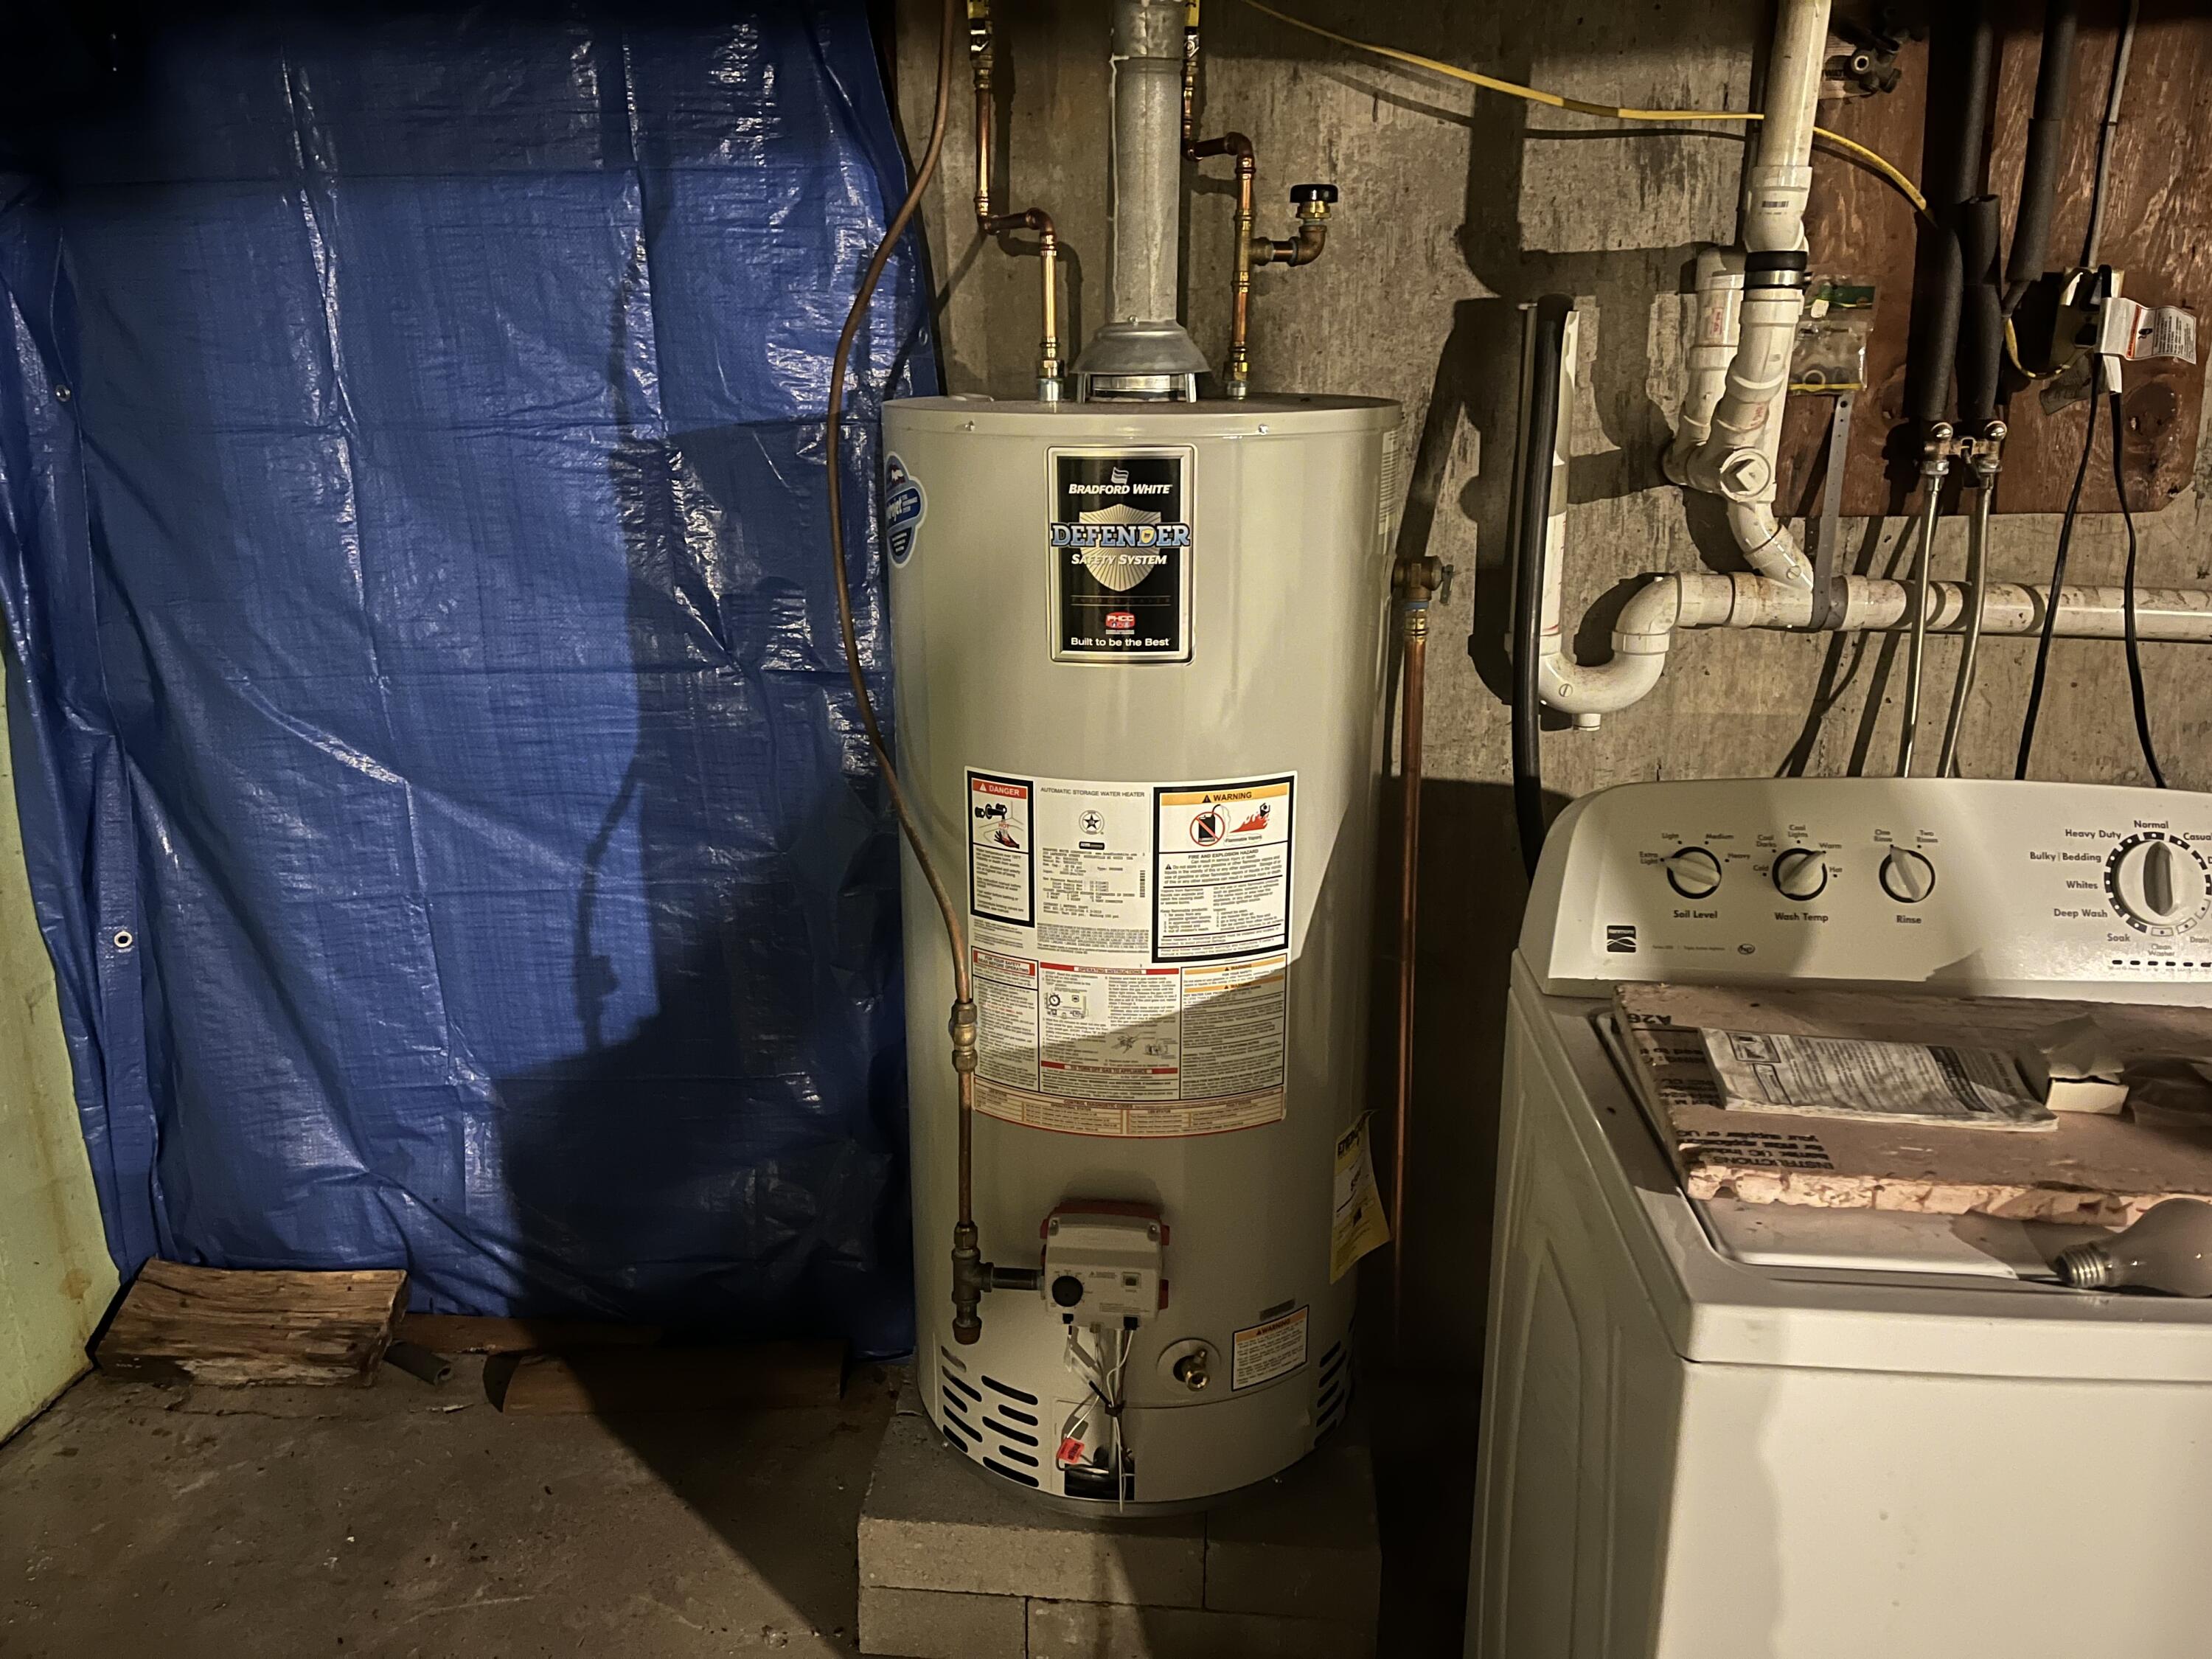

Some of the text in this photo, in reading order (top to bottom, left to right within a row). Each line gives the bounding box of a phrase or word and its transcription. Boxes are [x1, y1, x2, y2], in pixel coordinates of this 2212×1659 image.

[1069, 484, 1170, 494] BRADFORD WHITE
[1051, 522, 1190, 548] DEFENDER
[1071, 554, 1167, 565] SAFETY SYSTEM
[1071, 638, 1093, 646] Built
[1108, 638, 1122, 646] be
[989, 785, 1020, 796] DANGER
[1040, 787, 1071, 795] AUTOMATIC
[1213, 792, 1252, 801] WARNING
[2134, 820, 2169, 830] Normal
[2065, 829, 2121, 840] Heavy Duty
[2029, 852, 2101, 863] Bulky Bedding
[2066, 880, 2098, 889] Whites
[1673, 910, 1718, 919] Soil Level
[1774, 911, 1829, 923] Wash Temp
[2053, 908, 2108, 918] Deep Wash
[1896, 914, 1921, 924] Rinse
[2107, 932, 2131, 942] Soak
[1005, 964, 1029, 973] OPERATING
